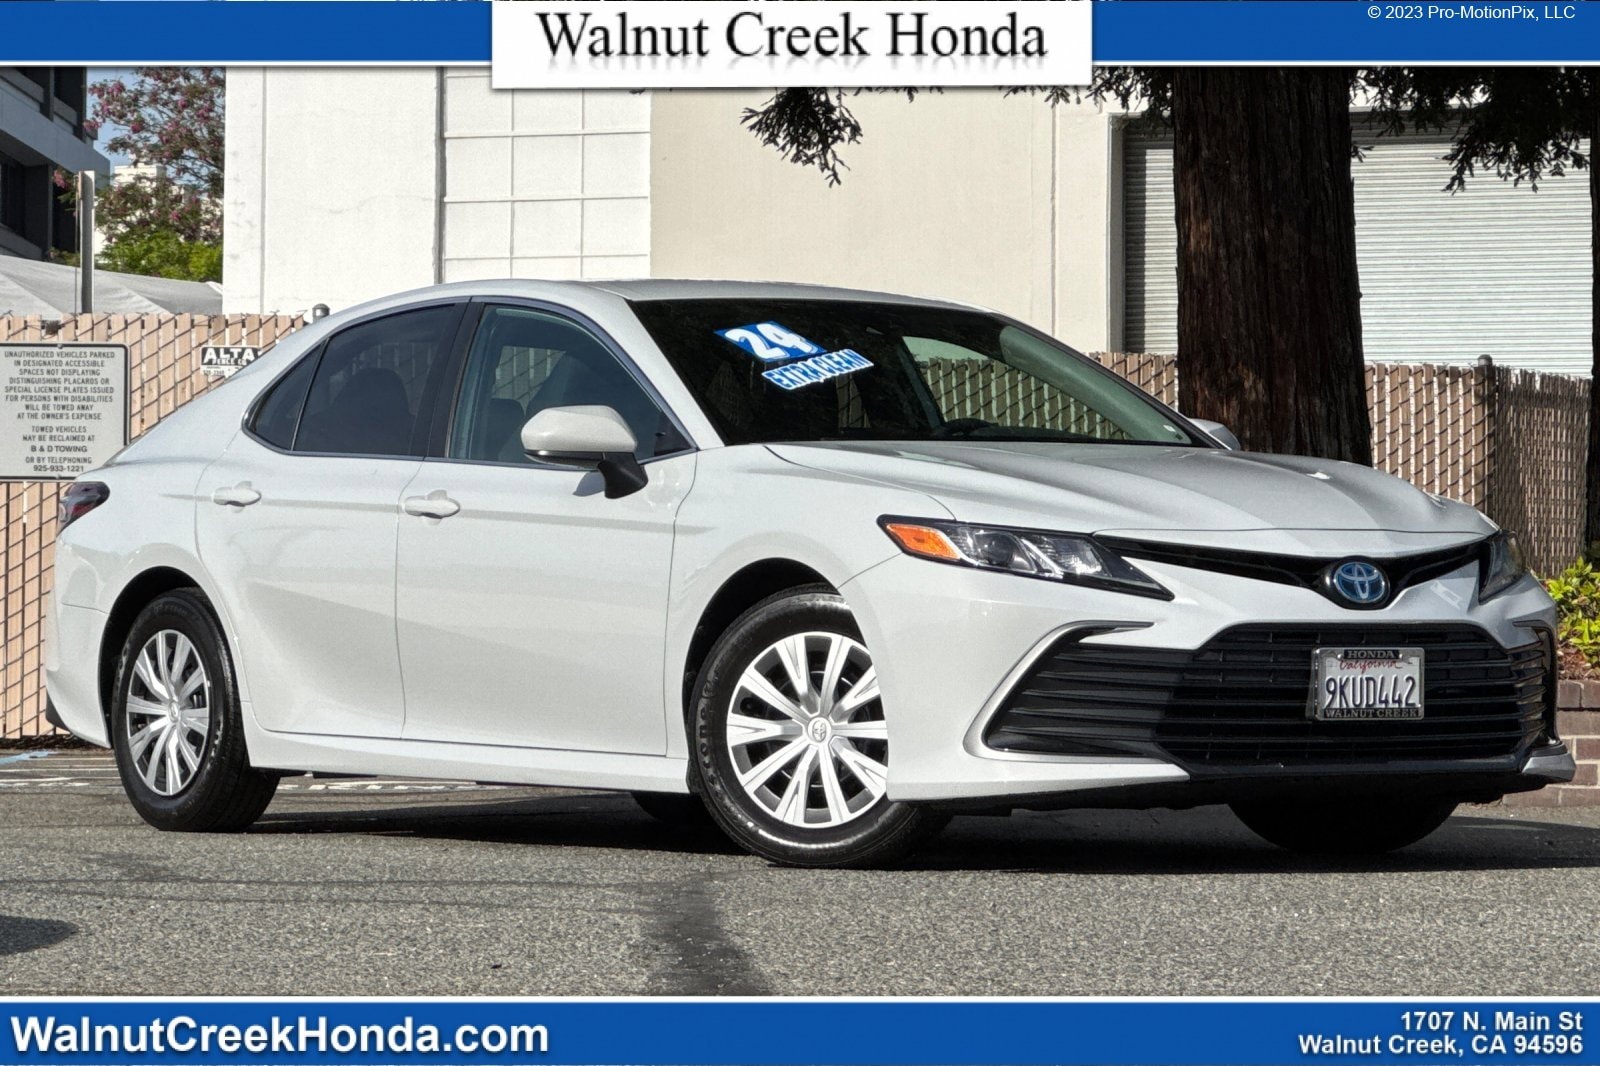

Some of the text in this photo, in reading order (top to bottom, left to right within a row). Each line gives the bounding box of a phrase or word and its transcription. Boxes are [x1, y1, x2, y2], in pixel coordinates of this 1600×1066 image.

[725, 323, 819, 359] 24
[203, 347, 255, 364] ALTA
[1347, 650, 1396, 659] HONDA
[1325, 674, 1417, 709] 9KUD442
[1325, 708, 1420, 718] WALNUT CREEK
